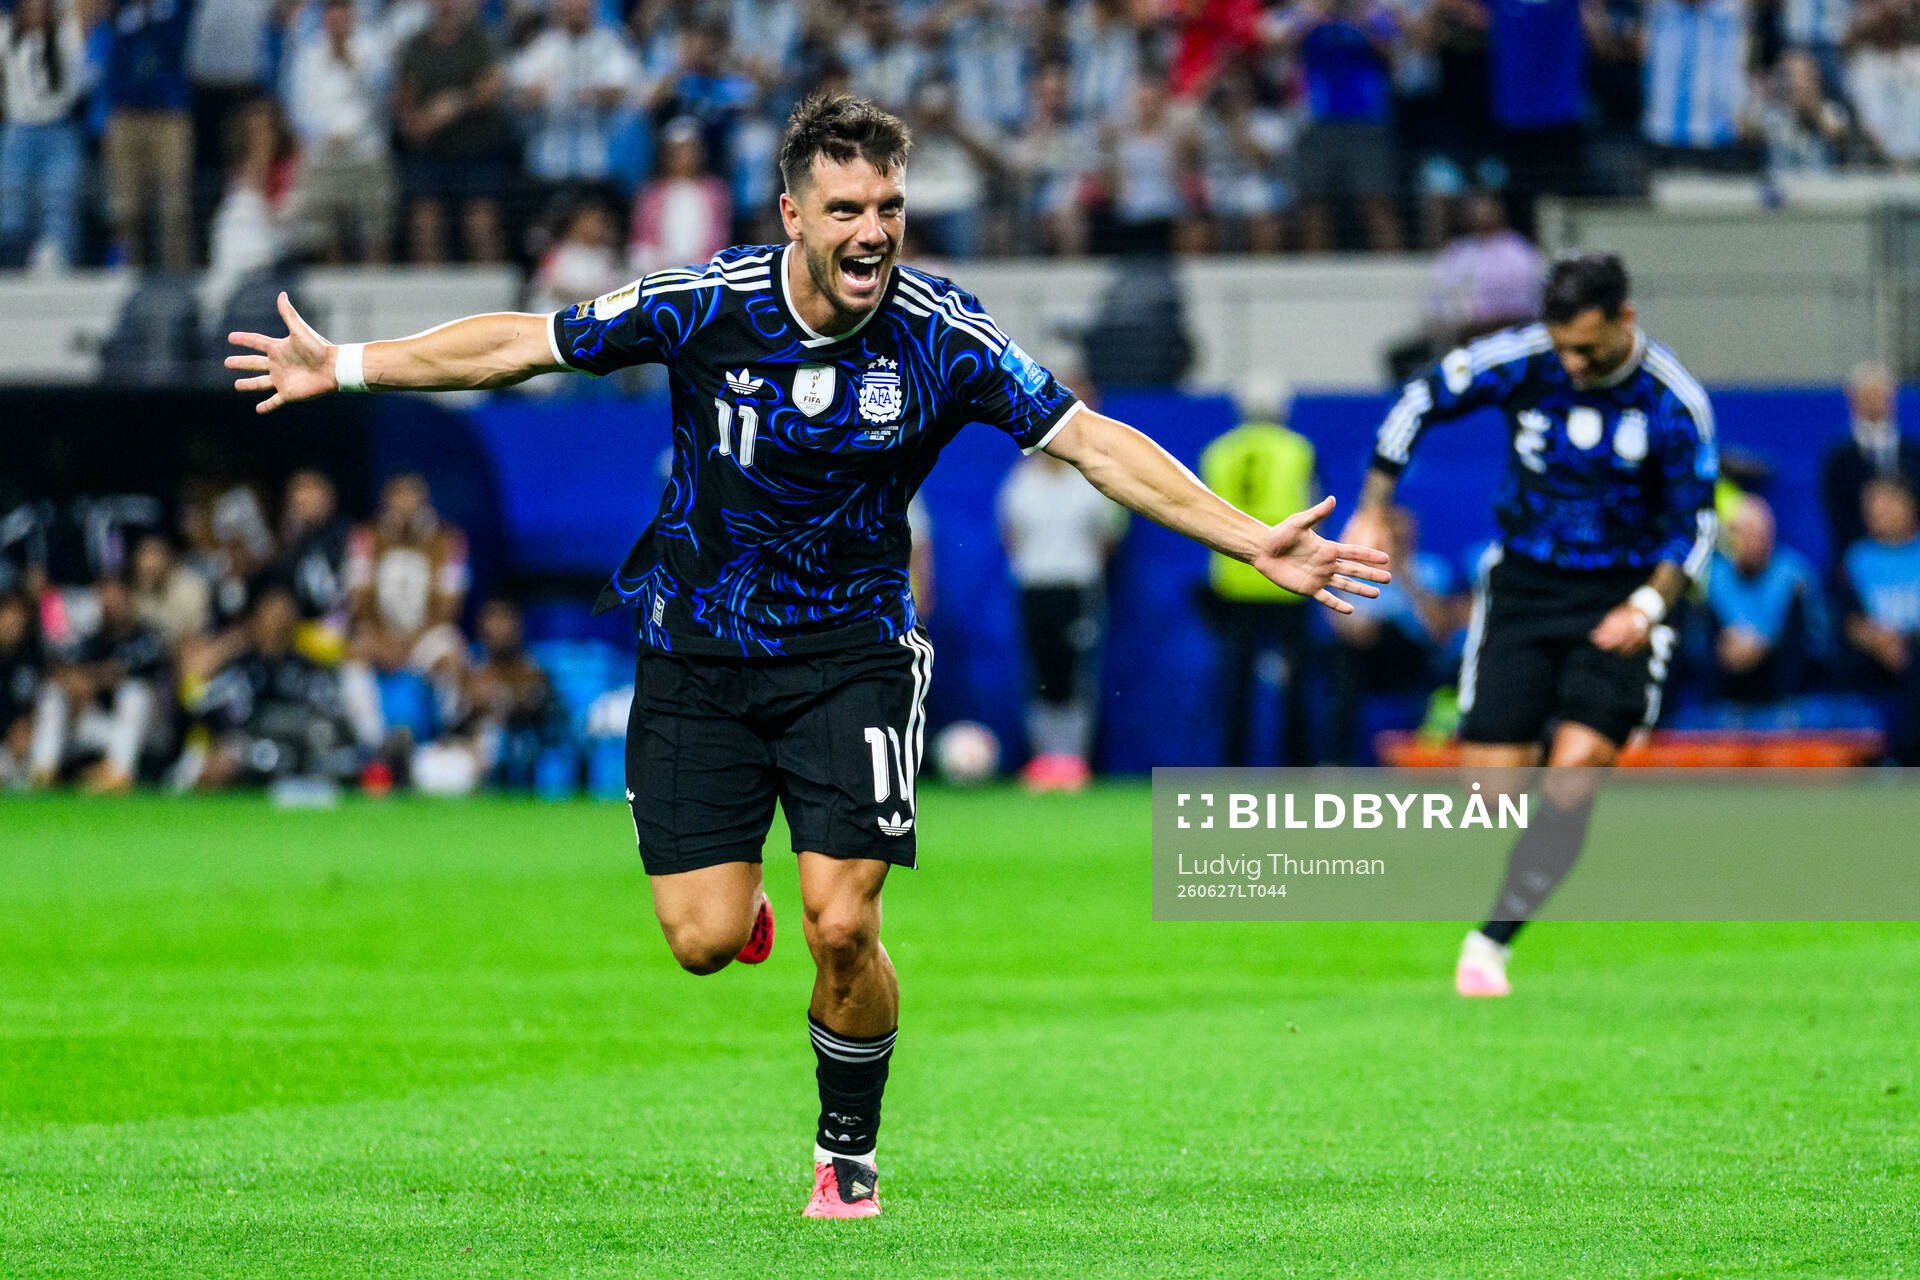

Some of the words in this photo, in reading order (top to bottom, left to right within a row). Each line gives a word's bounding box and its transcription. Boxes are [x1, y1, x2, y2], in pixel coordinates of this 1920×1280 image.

[803, 395, 821, 404] FIFA
[867, 386, 893, 408] AFA
[714, 397, 759, 469] 11
